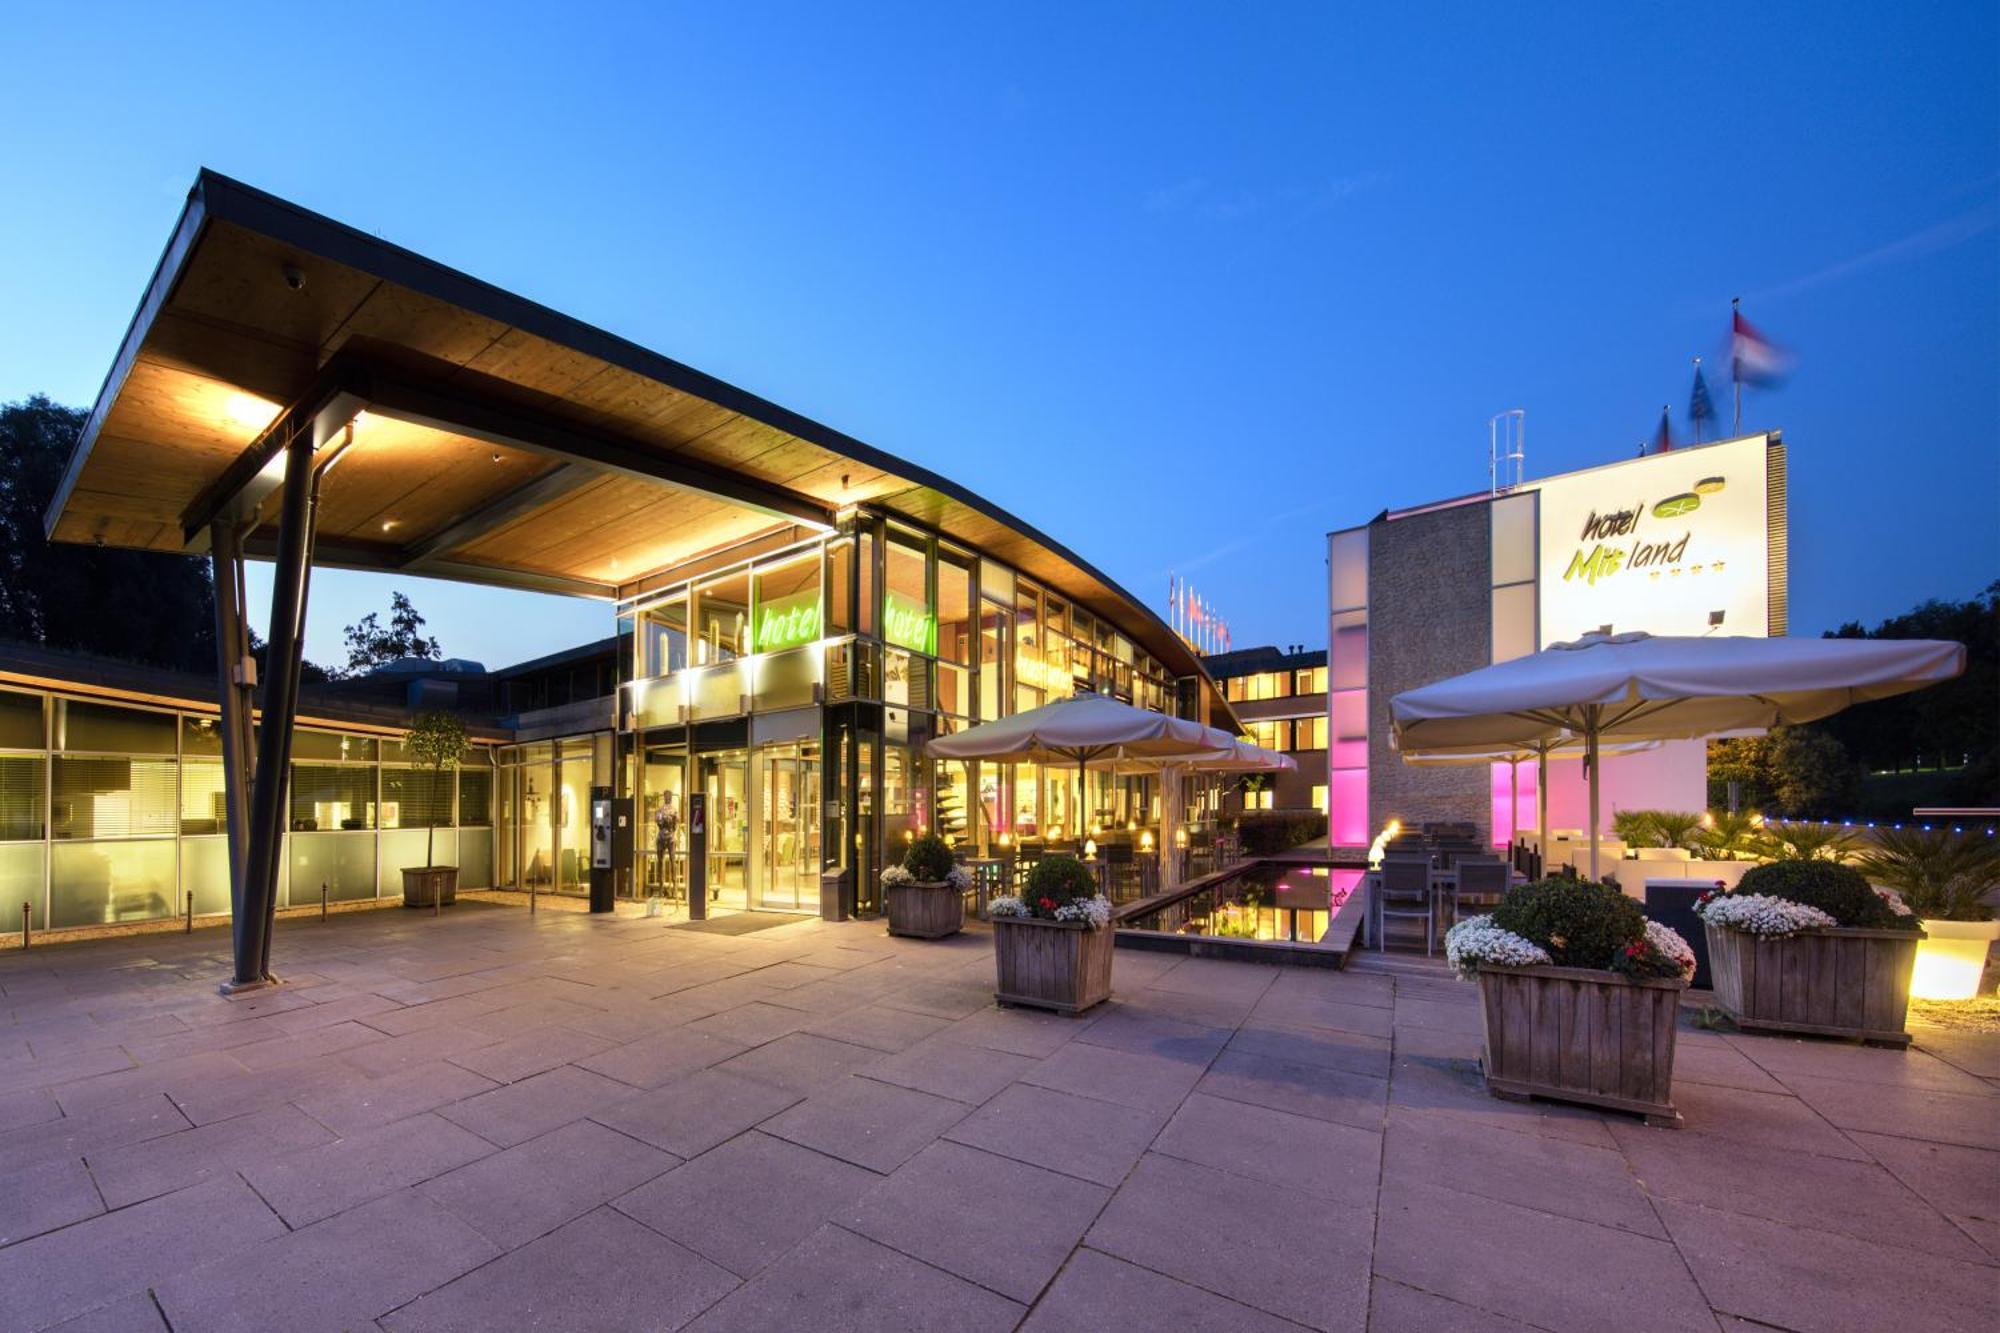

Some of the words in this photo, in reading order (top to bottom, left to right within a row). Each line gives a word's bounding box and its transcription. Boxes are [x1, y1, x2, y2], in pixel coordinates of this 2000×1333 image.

[1581, 503, 1643, 541] hotel
[758, 595, 822, 646] hotel
[885, 595, 929, 651] hotel
